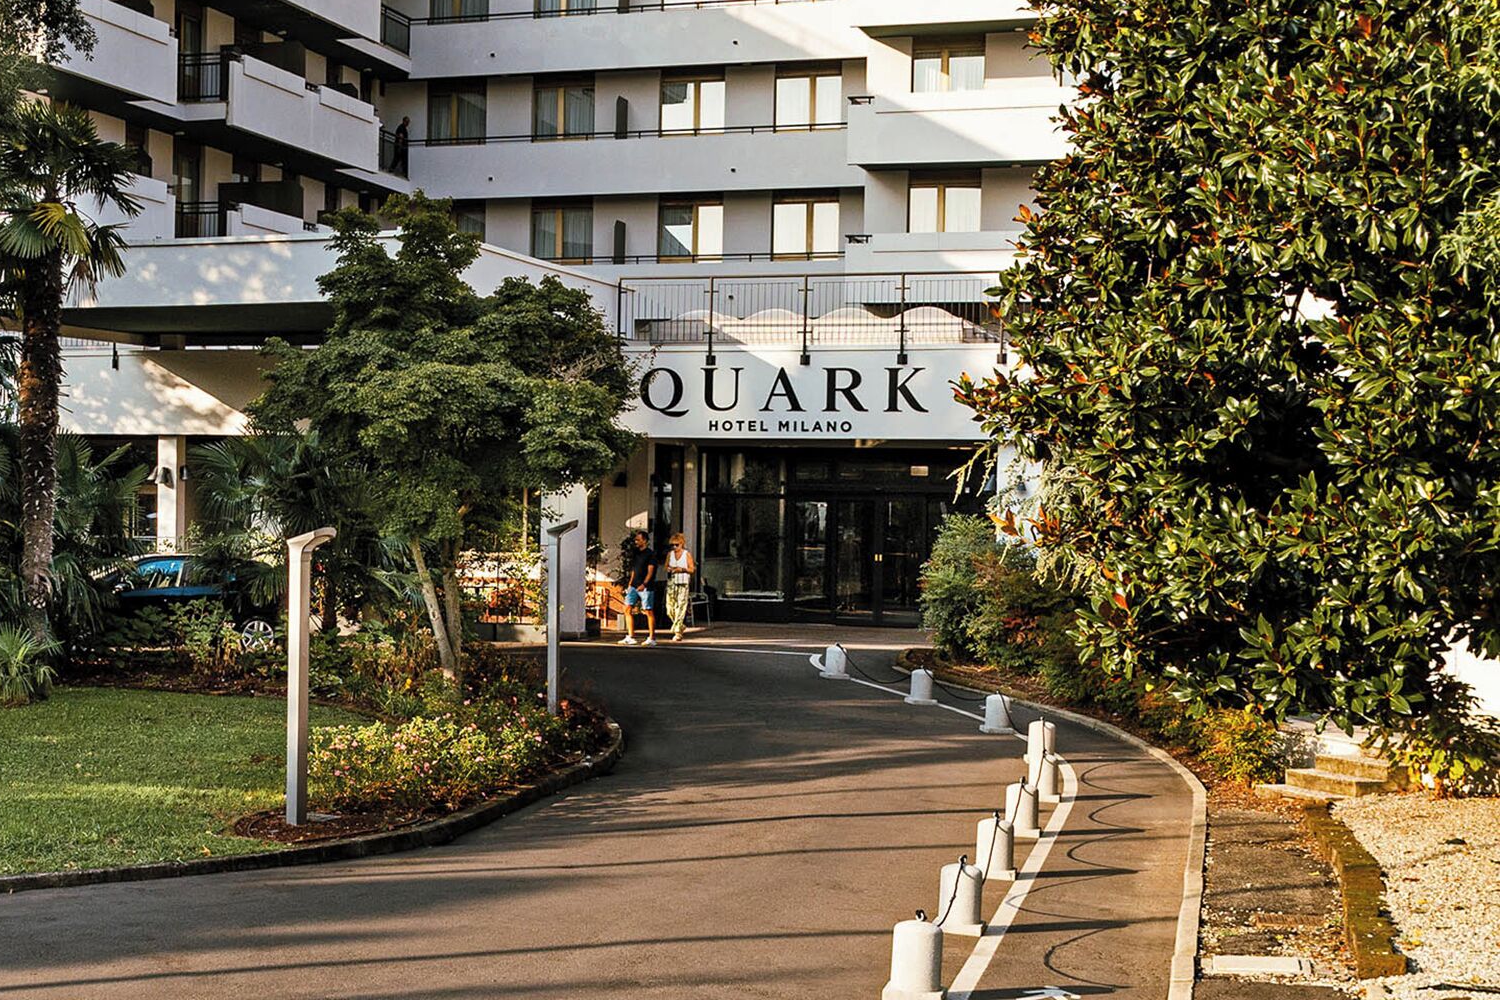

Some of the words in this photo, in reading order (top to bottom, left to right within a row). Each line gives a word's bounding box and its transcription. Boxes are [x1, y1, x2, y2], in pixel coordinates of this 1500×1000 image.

[640, 366, 929, 418] QUARK
[708, 420, 769, 432] HOTEL
[778, 420, 853, 433] MILANO
